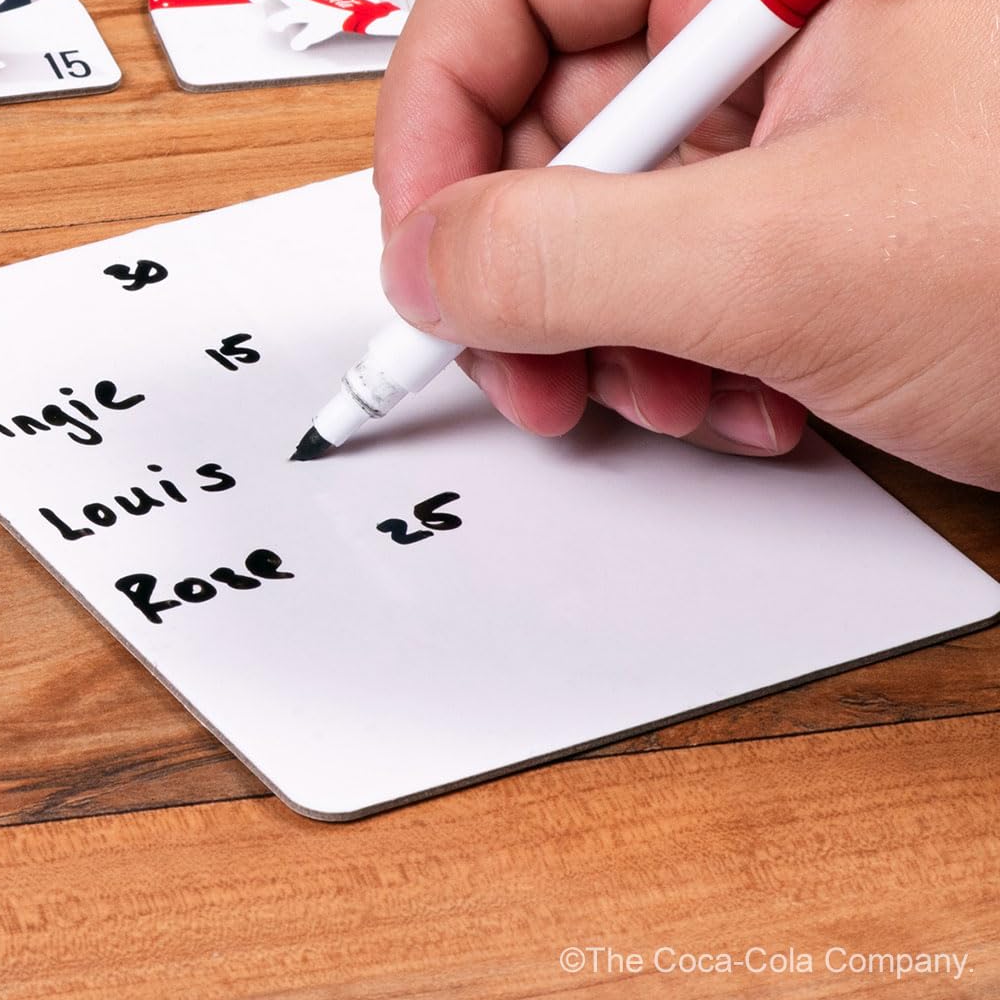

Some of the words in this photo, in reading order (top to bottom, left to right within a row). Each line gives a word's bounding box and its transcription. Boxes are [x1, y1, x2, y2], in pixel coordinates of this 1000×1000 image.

[43, 50, 93, 80] 15
[103, 259, 169, 291] 30
[205, 332, 261, 371] 15
[39, 462, 236, 541] Louis
[115, 548, 295, 624] Rose
[376, 491, 463, 545] 25
